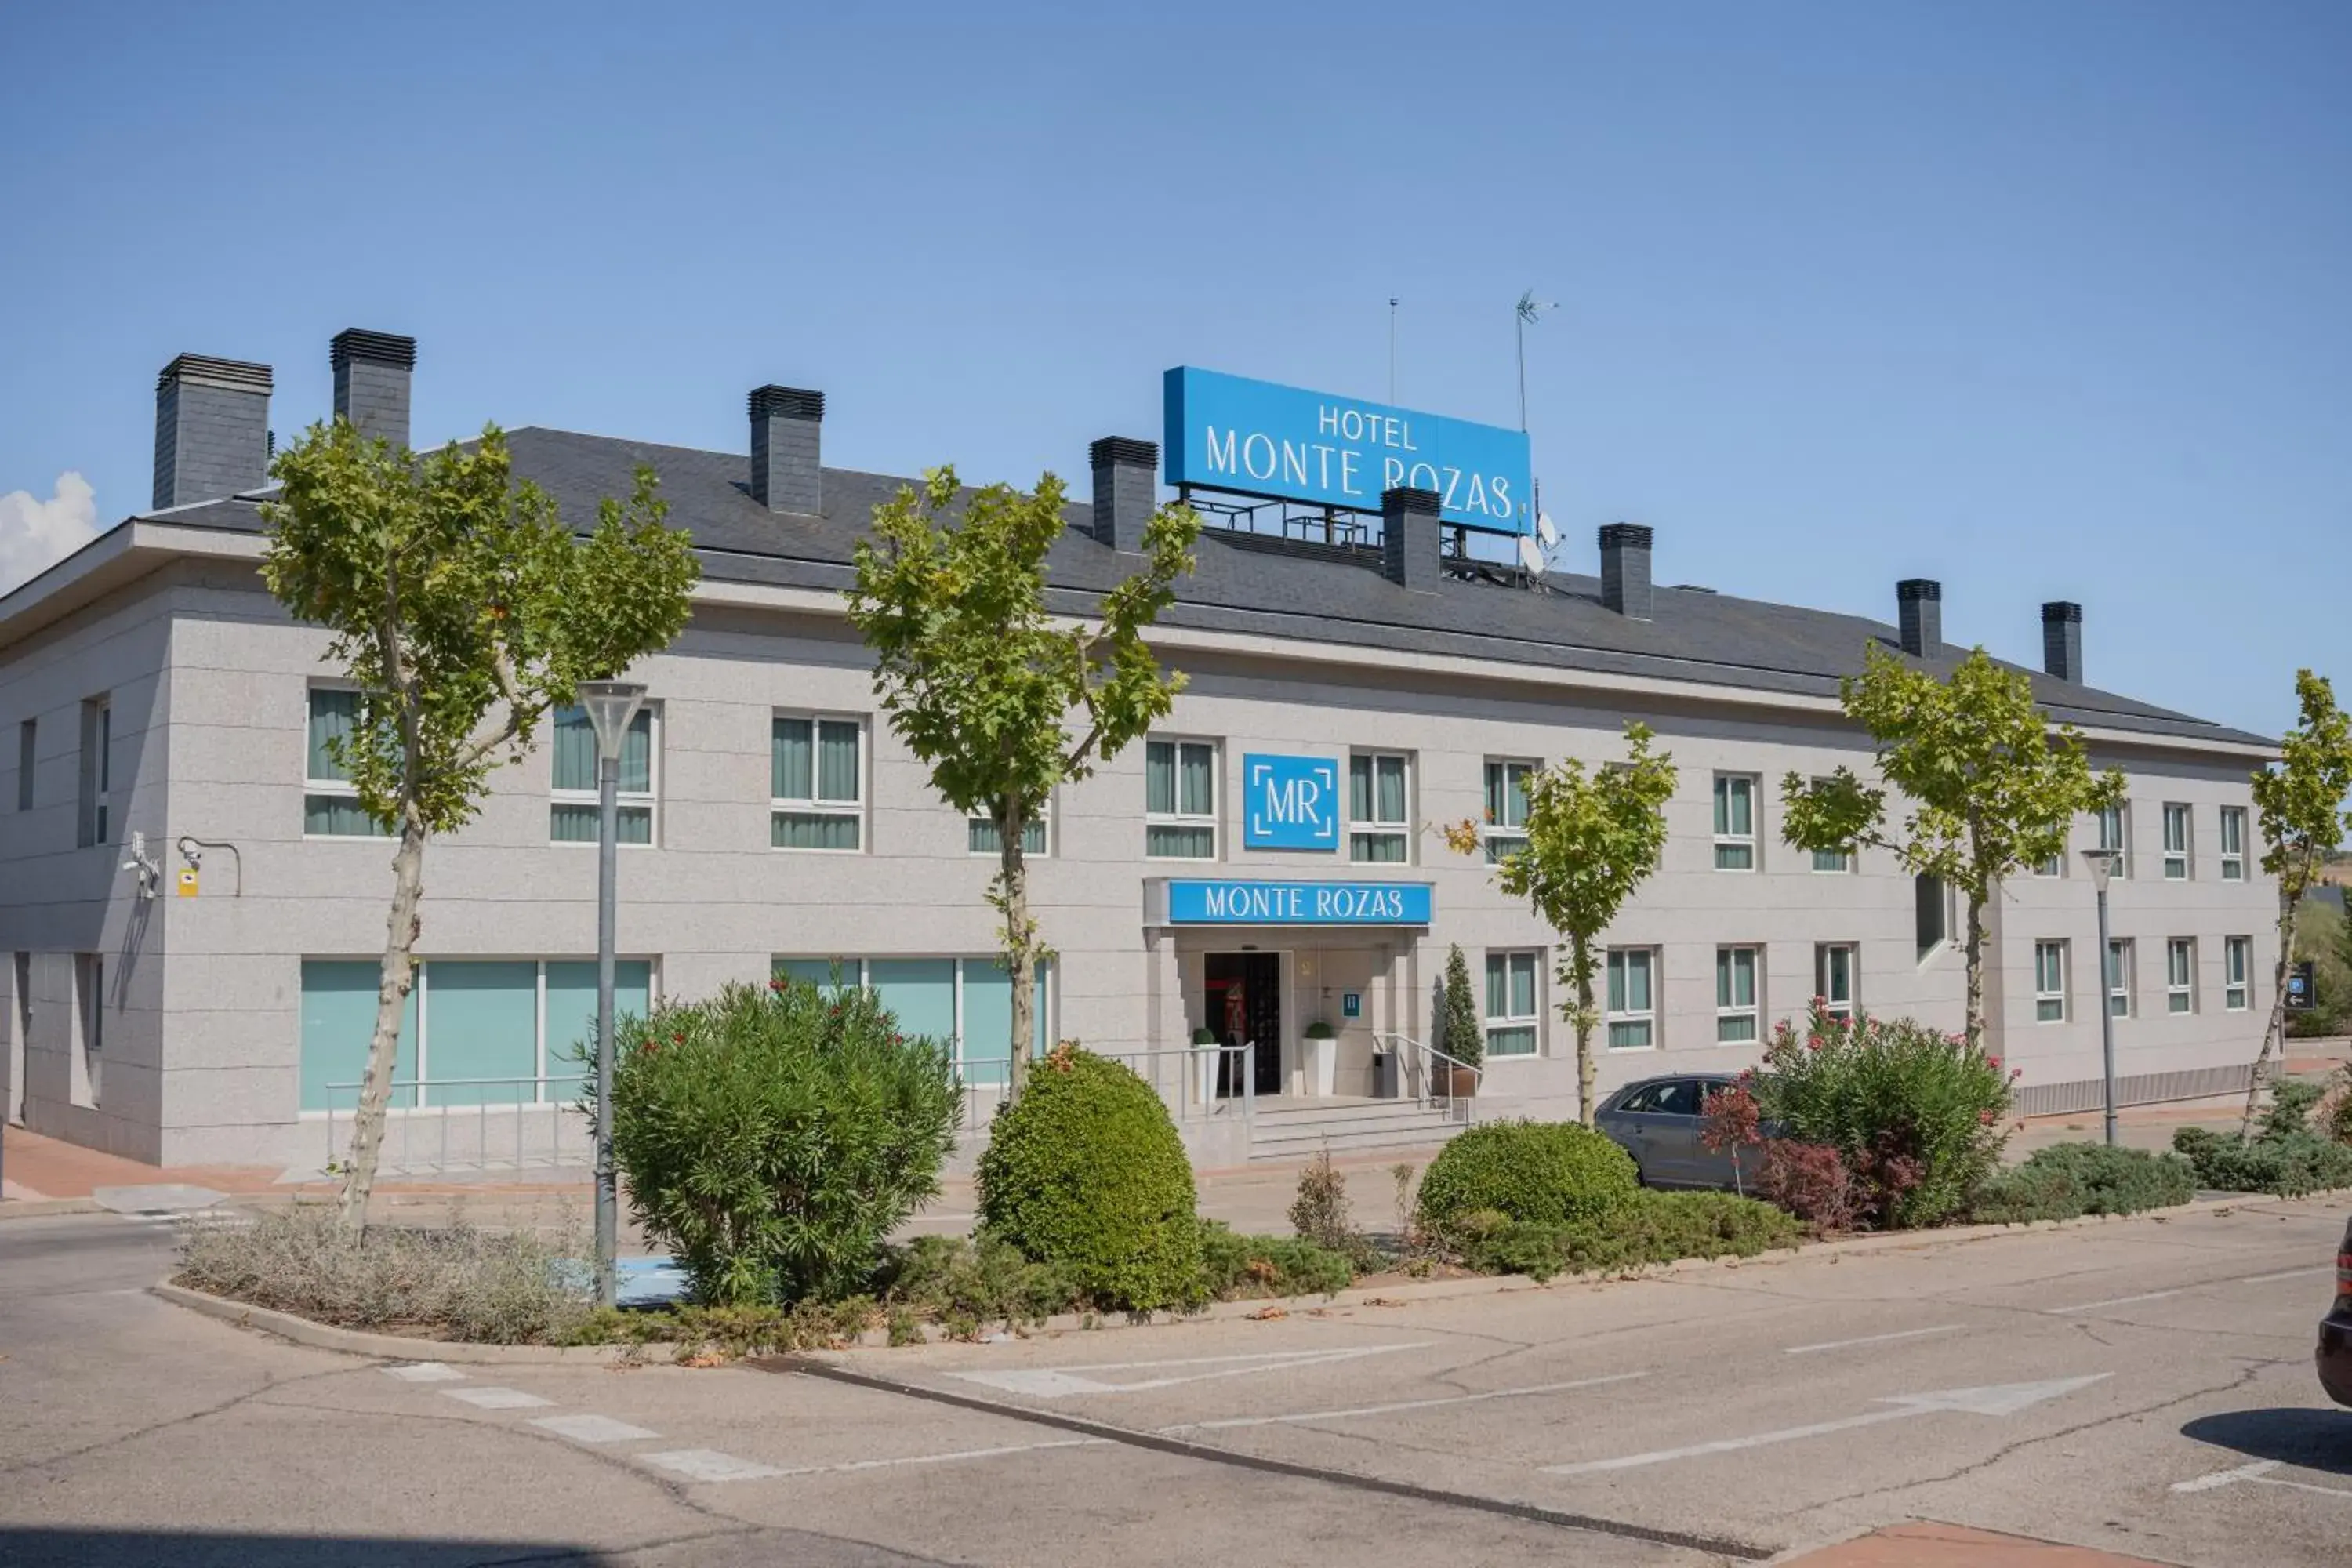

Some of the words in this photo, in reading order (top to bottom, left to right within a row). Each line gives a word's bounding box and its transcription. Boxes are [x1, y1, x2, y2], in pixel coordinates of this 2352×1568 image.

[1319, 405, 1417, 451] HOTEL
[1207, 426, 1363, 495] MONTE
[1385, 456, 1512, 518] ROZAS
[1266, 778, 1320, 824] MR
[1206, 886, 1305, 916] MONTE
[1316, 889, 1403, 917] ROZAS
